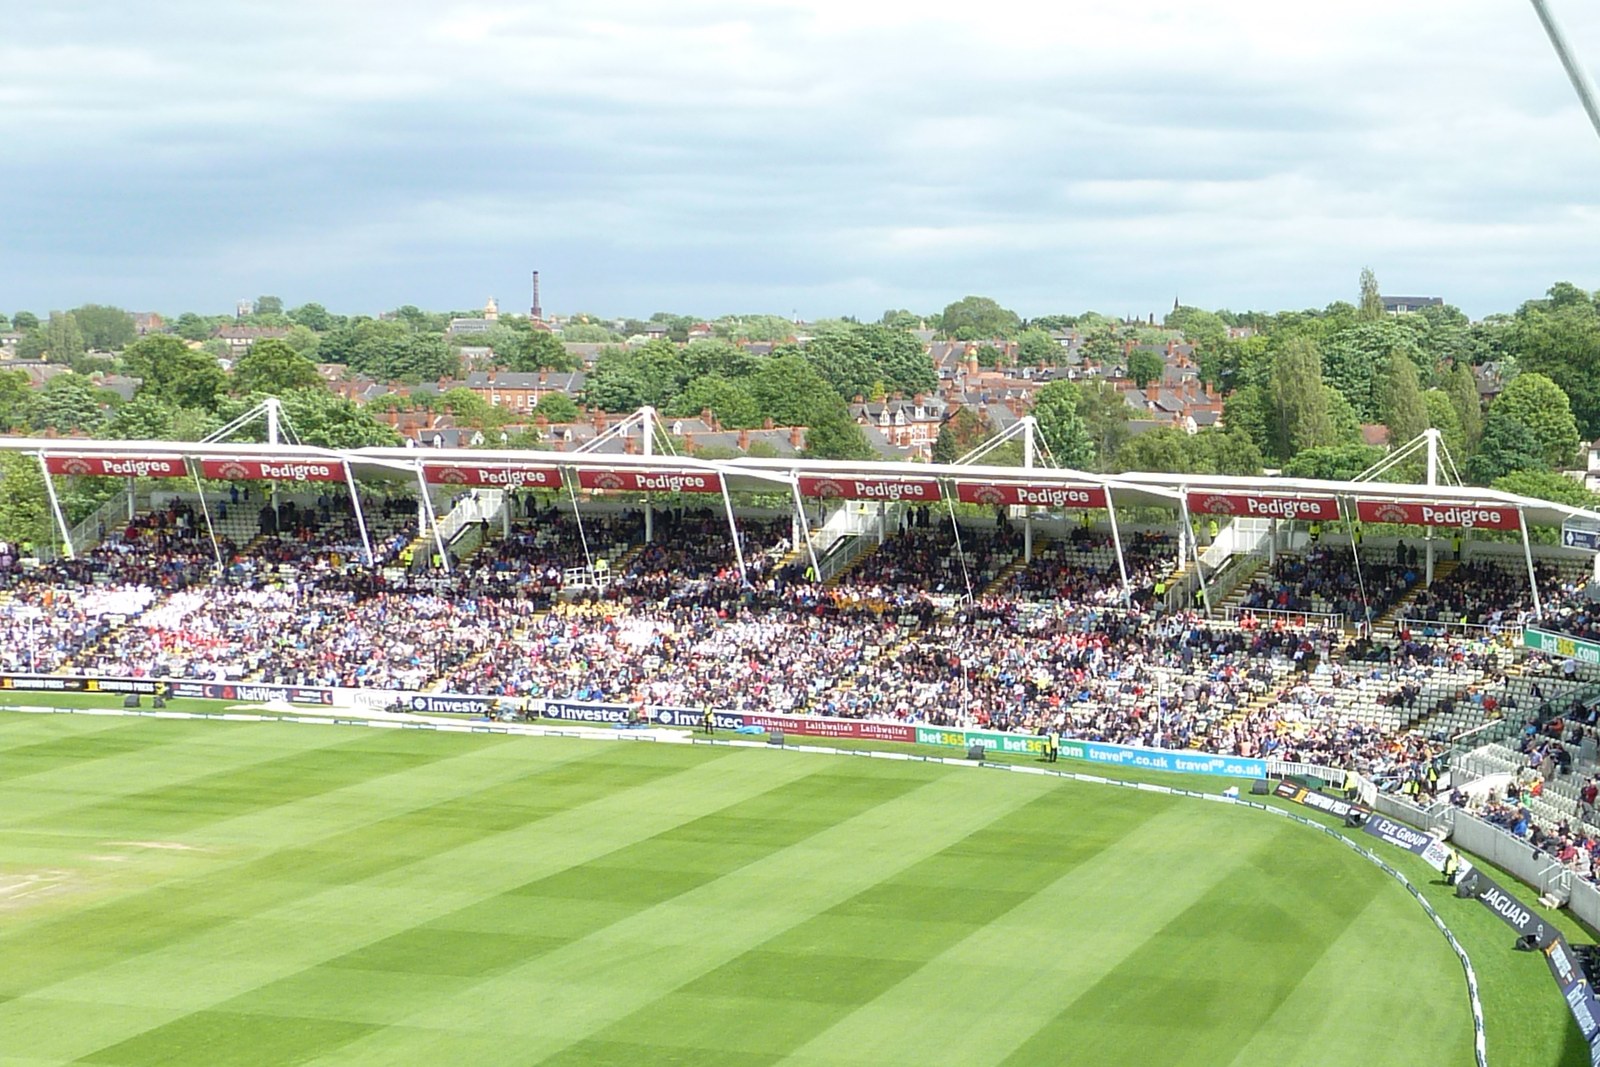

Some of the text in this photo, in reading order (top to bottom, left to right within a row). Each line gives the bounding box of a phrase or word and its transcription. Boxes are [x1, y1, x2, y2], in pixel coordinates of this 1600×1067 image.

[102, 459, 170, 477] Pedigree
[260, 463, 329, 480] Pedigree
[478, 469, 546, 488] Pedigree
[636, 474, 704, 491] Pedigree
[855, 482, 923, 500] Pedigree
[1017, 488, 1089, 507] Pedigree
[1247, 498, 1321, 519] Pedigree
[1422, 506, 1501, 527] Pedigree
[1541, 633, 1600, 662] bet365.com
[236, 686, 288, 701] NatWest
[752, 716, 798, 729] Laithwaite's
[805, 721, 853, 732] Laithwaite's
[860, 724, 908, 736] Laithwaite's
[919, 729, 997, 749] bet365.com
[1089, 748, 1262, 775] travelup.co.uk travelup.co.uk
[1480, 887, 1531, 929] JAGUAR
